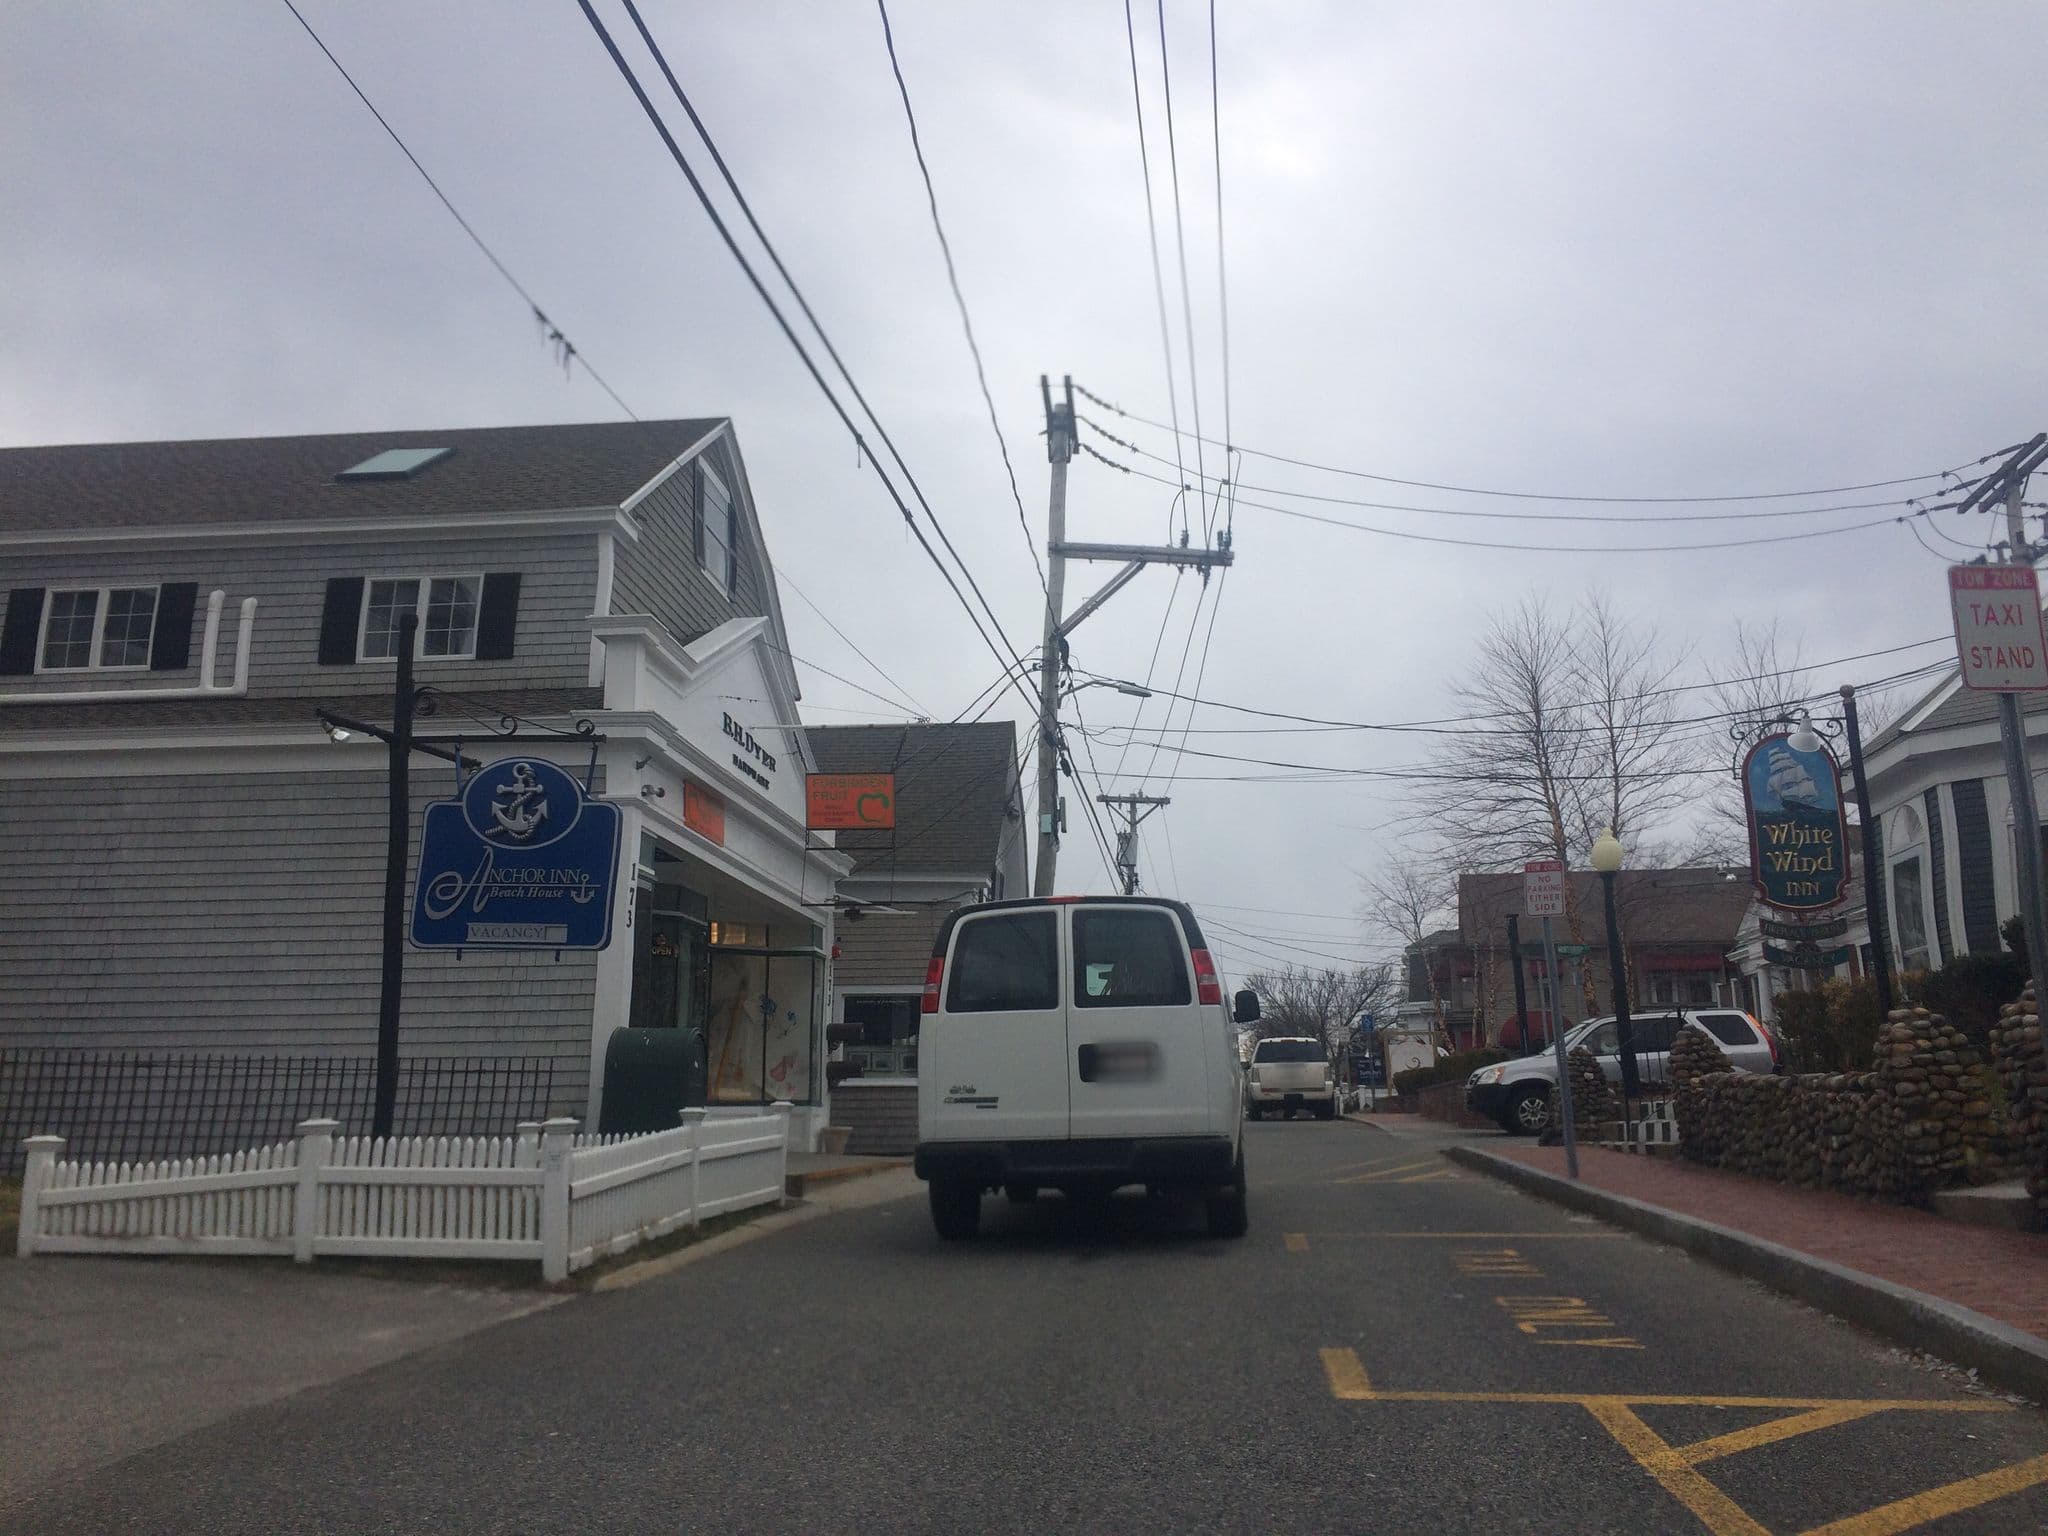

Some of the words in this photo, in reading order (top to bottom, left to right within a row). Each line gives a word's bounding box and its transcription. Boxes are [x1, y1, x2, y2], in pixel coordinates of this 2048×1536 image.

[1990, 568, 2034, 586] ZONE
[1970, 603, 2023, 626] TAXI
[1971, 646, 2035, 669] STAND
[1763, 820, 1833, 848] White
[1766, 848, 1833, 875] Wind
[550, 868, 581, 884] INN
[1538, 875, 1551, 883] NO
[489, 886, 525, 898] Beach
[526, 887, 565, 899] House
[1786, 881, 1820, 897] INN
[1529, 894, 1560, 902] EITHER
[1534, 903, 1556, 911] SIDE
[470, 926, 544, 938] VACANCY
[651, 946, 673, 956] OPEN
